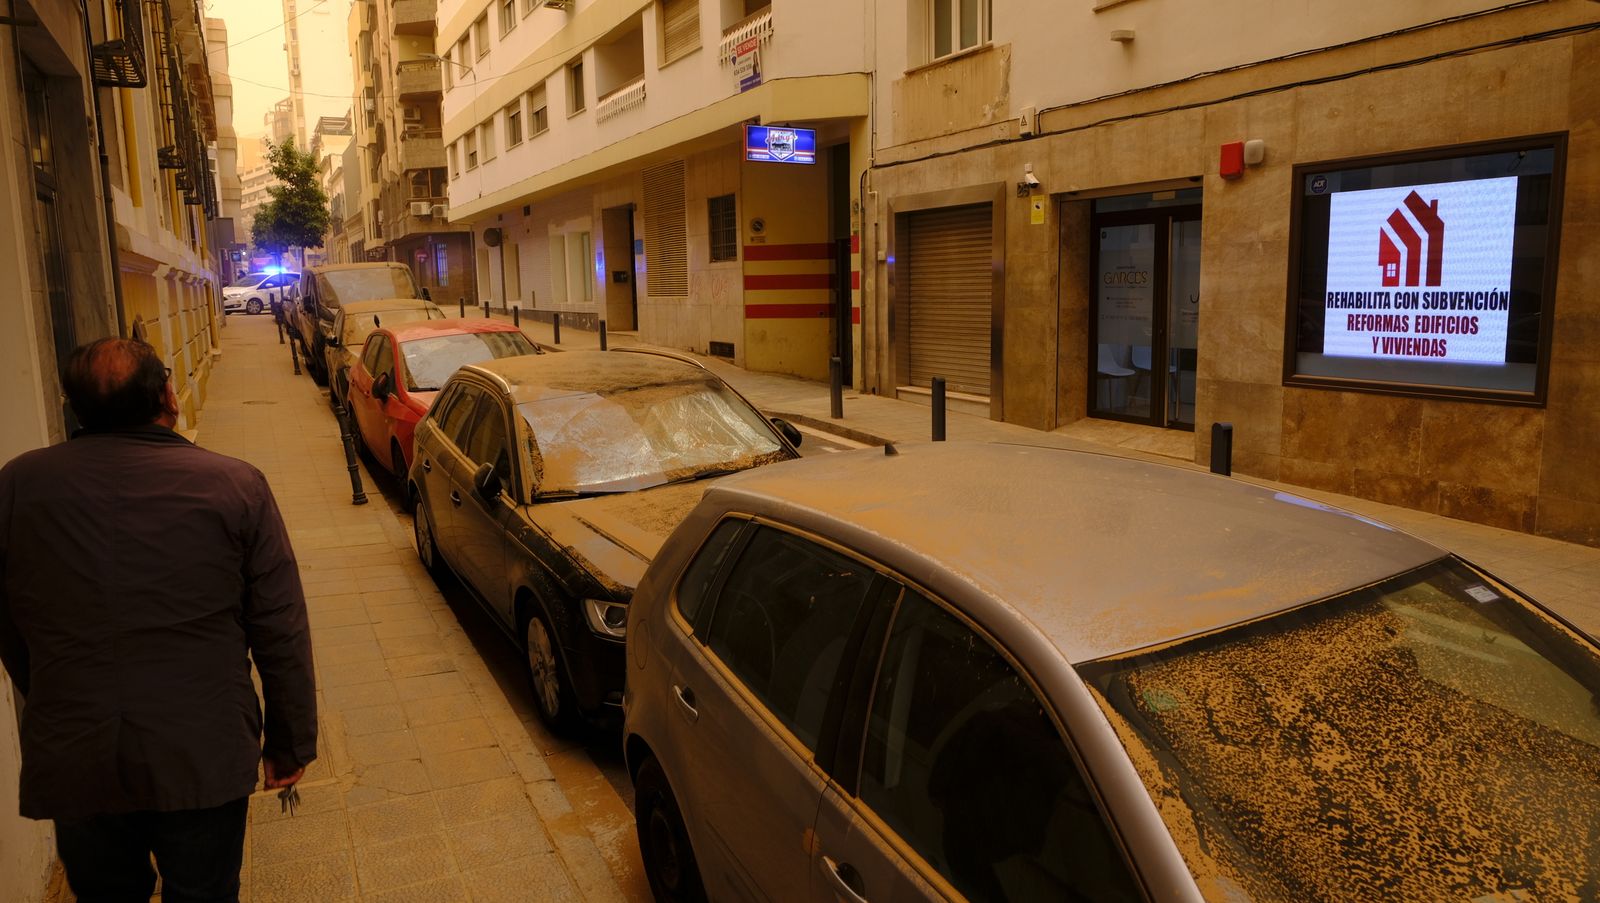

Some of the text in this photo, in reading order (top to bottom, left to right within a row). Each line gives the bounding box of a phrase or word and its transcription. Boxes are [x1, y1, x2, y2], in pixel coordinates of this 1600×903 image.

[1326, 287, 1509, 311] REHABILITA CON SUBVENCIÓN
[1347, 314, 1479, 335] REFORMAS EDIFICIOS
[1372, 337, 1447, 357] Y VIVIENDAS
